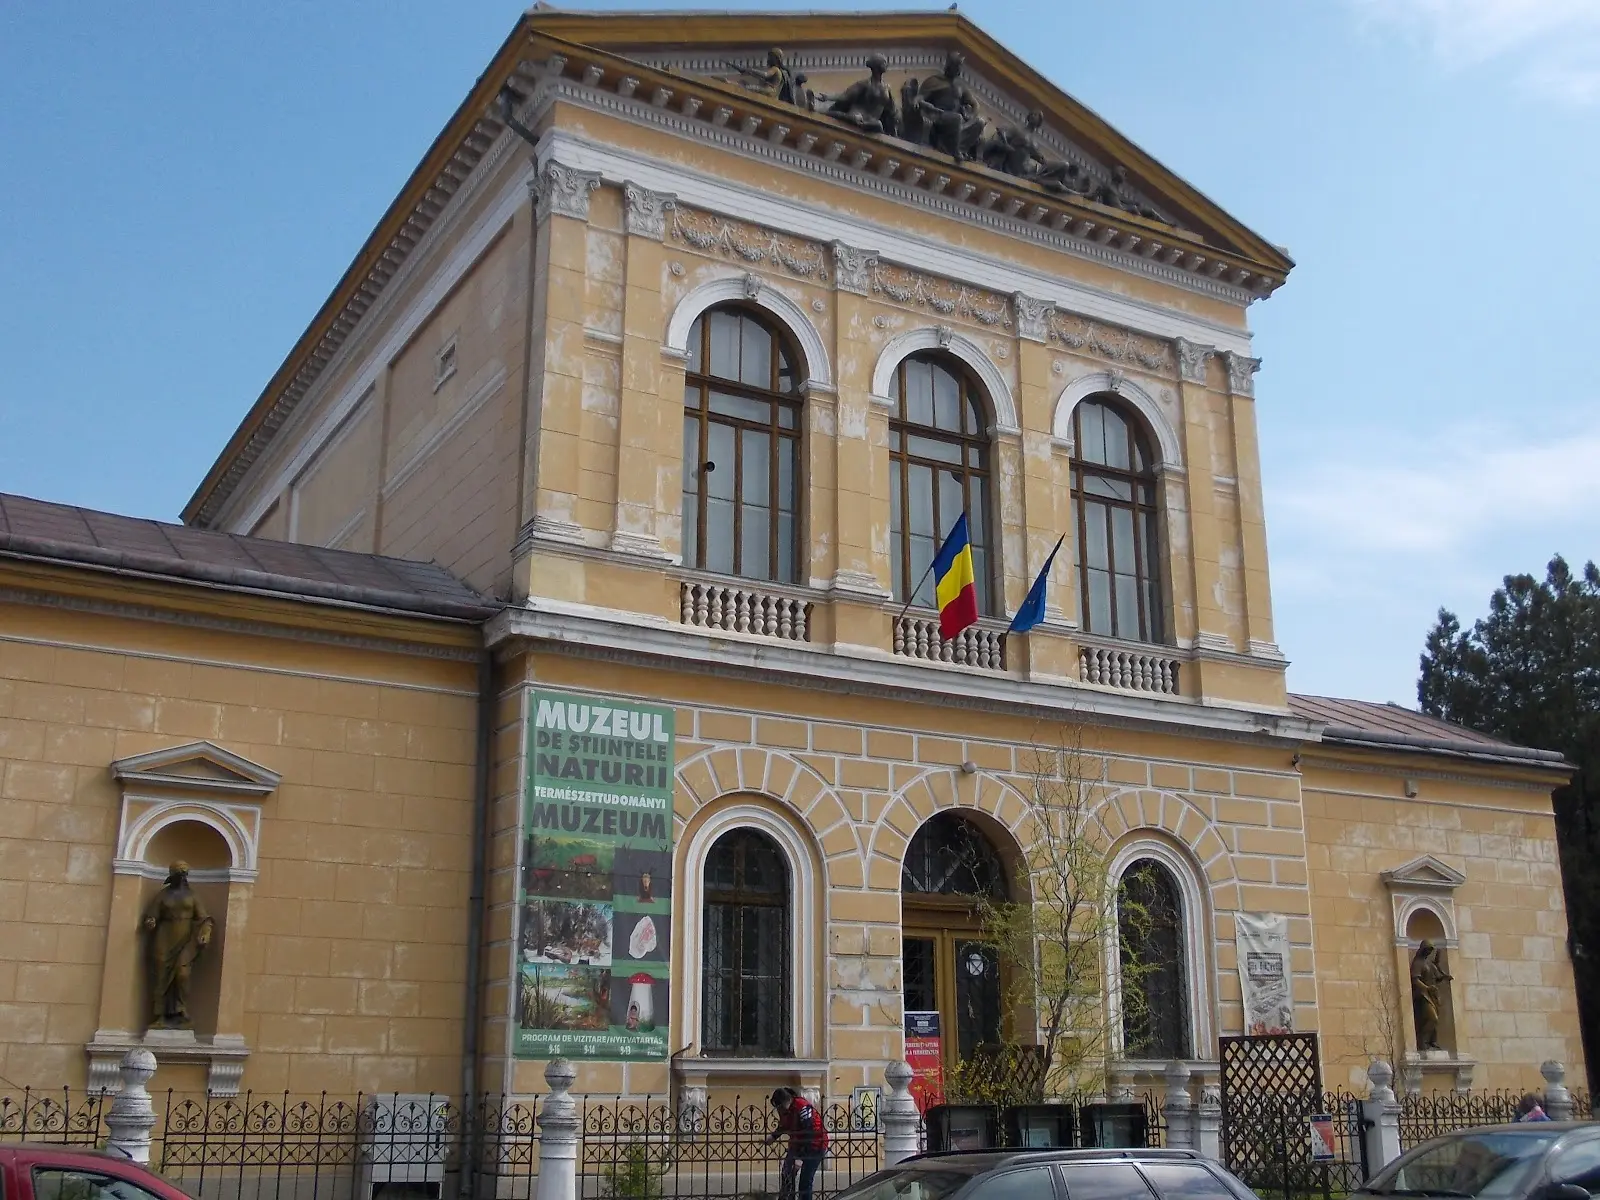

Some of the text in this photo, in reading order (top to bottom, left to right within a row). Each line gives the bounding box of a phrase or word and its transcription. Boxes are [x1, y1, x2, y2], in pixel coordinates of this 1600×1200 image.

[535, 700, 669, 742] MUZEUL
[536, 731, 561, 750] DE
[536, 753, 667, 788] NATURII
[534, 786, 666, 809] TERMÉSZETTUDOMÁNYI
[521, 1034, 561, 1042] PROGRAM
[562, 1035, 571, 1043] DE
